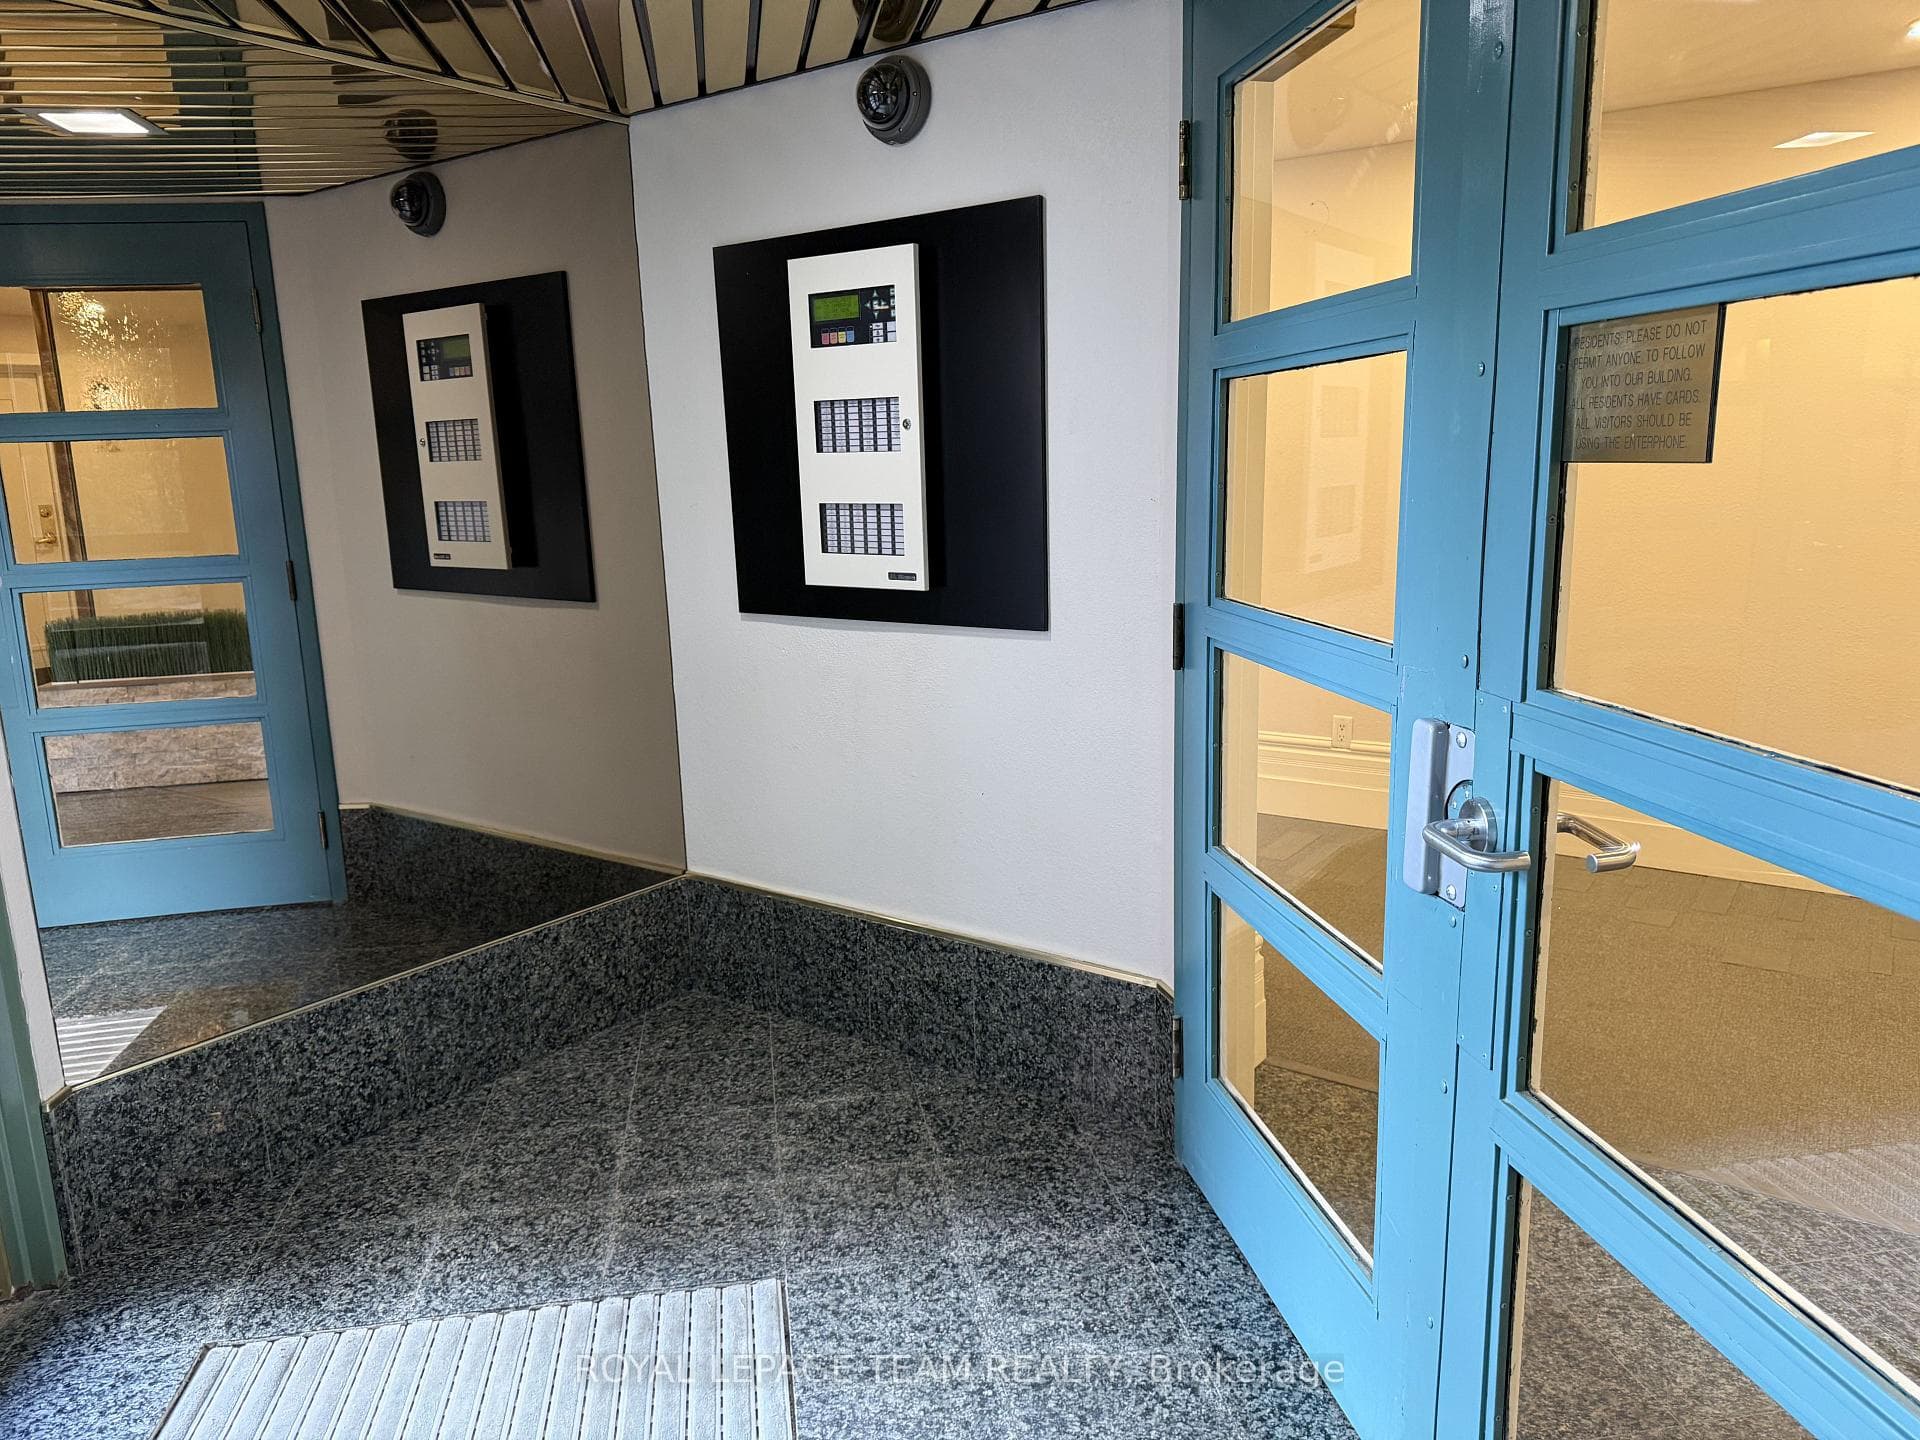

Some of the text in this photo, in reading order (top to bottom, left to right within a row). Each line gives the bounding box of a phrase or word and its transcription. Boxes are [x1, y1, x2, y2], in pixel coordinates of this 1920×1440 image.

[1626, 326, 1662, 343] PLEASE
[1666, 322, 1680, 339] DO
[1685, 320, 1707, 336] NOT
[1572, 343, 1706, 370] PERMIT ANYONE TO FOLLOW
[1581, 376, 1597, 391] YOU
[1600, 374, 1621, 389] INTO
[1624, 371, 1644, 386] OUR
[1588, 393, 1634, 409] RESIDENTS
[1637, 391, 1661, 407] HAVE
[1575, 412, 1693, 430] ALL VISITORS SHOULD BE
[1604, 436, 1621, 449] THE
